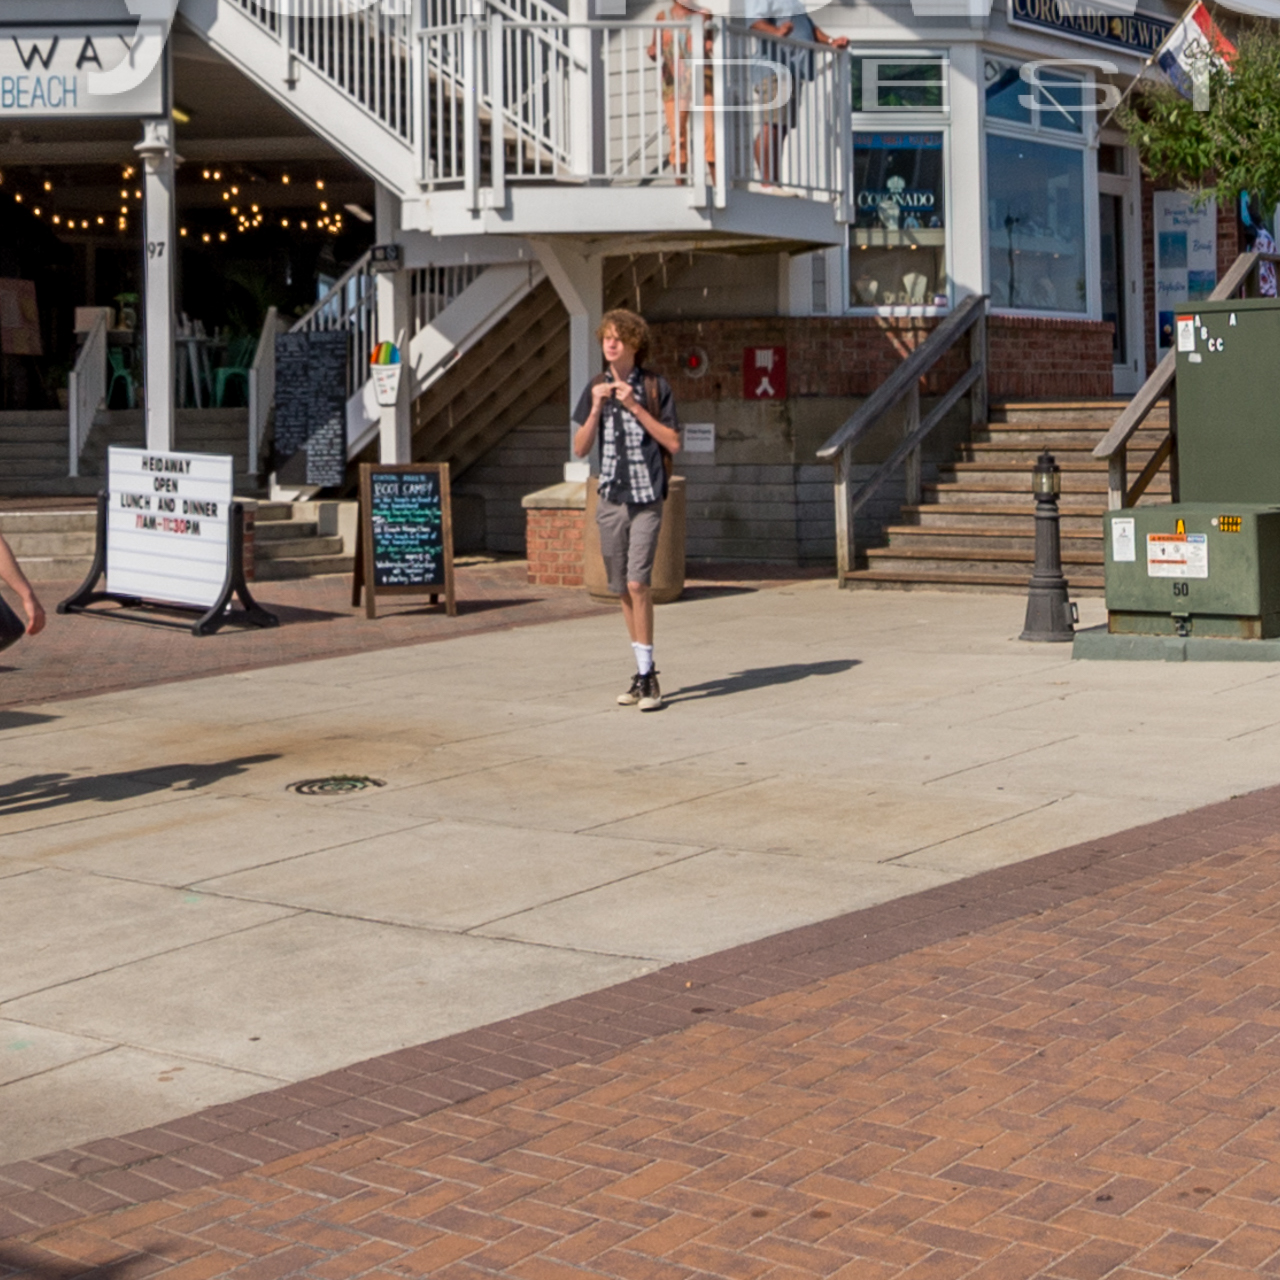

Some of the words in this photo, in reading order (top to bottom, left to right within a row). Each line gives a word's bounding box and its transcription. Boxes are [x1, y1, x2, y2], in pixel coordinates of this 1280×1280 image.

[1, 75, 77, 108] BEACH
[147, 242, 166, 259] 97
[142, 456, 191, 475] HEIDAWAY
[154, 477, 178, 493] OPEN
[374, 482, 399, 496] BOOT
[121, 493, 151, 510] LUNCH
[158, 498, 176, 513] AND
[183, 500, 218, 518] DINNER
[1173, 583, 1189, 596] 50
